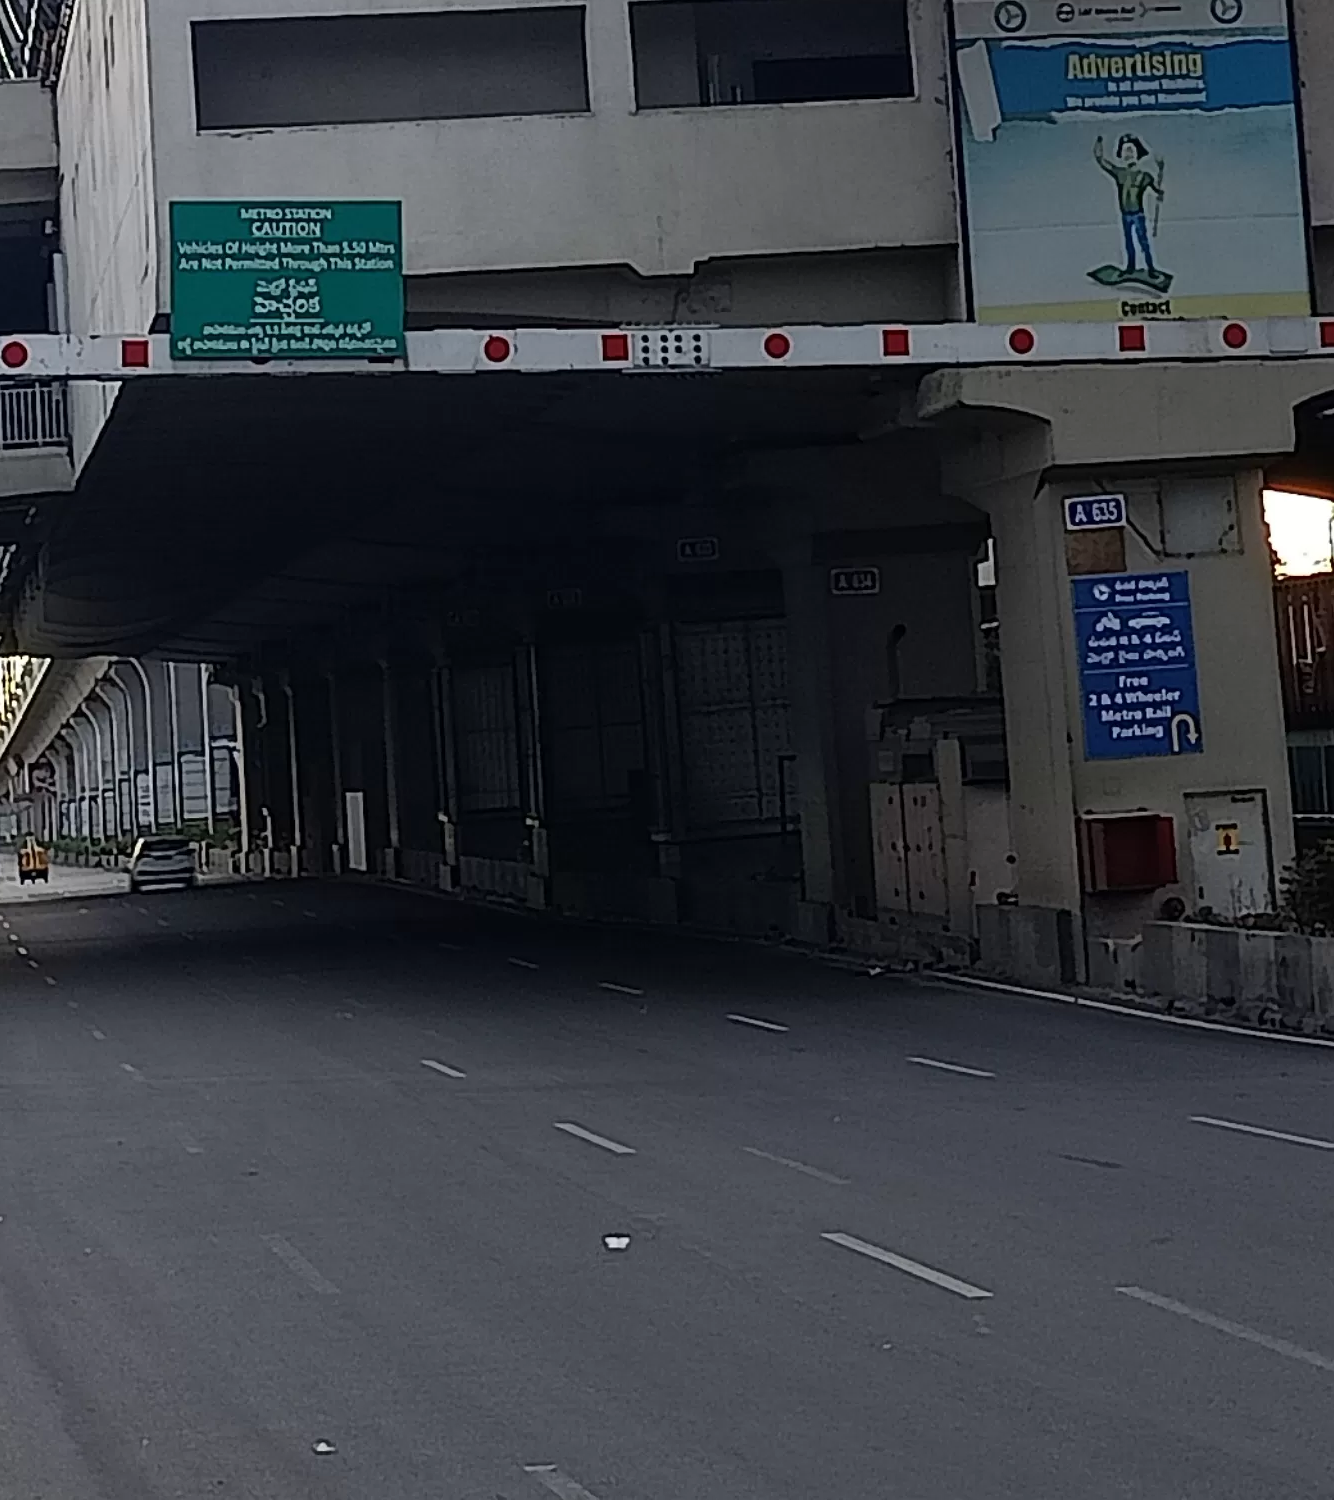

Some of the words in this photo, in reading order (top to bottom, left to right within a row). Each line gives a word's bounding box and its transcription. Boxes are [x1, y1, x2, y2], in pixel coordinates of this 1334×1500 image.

[1067, 51, 1204, 79] Advertising
[240, 208, 283, 219] METRO
[284, 208, 332, 219] STATION
[252, 221, 322, 237] CAUTION
[176, 241, 223, 254] Vehicles
[225, 241, 240, 254] Of
[242, 241, 277, 256] Height
[280, 241, 310, 254] More
[312, 241, 340, 254] Than
[178, 257, 199, 270] Are
[201, 257, 223, 270] Not
[225, 257, 279, 270] Permitted
[281, 257, 328, 272] Through
[329, 257, 352, 270] This
[353, 257, 395, 270] Station
[1121, 299, 1171, 317] Contact
[1075, 504, 1087, 523] A
[1092, 501, 1118, 522] 635
[1119, 675, 1149, 688] Free
[1088, 694, 1098, 706] 2
[1124, 688, 1181, 704] Wheeler
[1100, 709, 1143, 722] Metro
[1145, 704, 1172, 719] Rail
[1111, 723, 1164, 739] Parking
